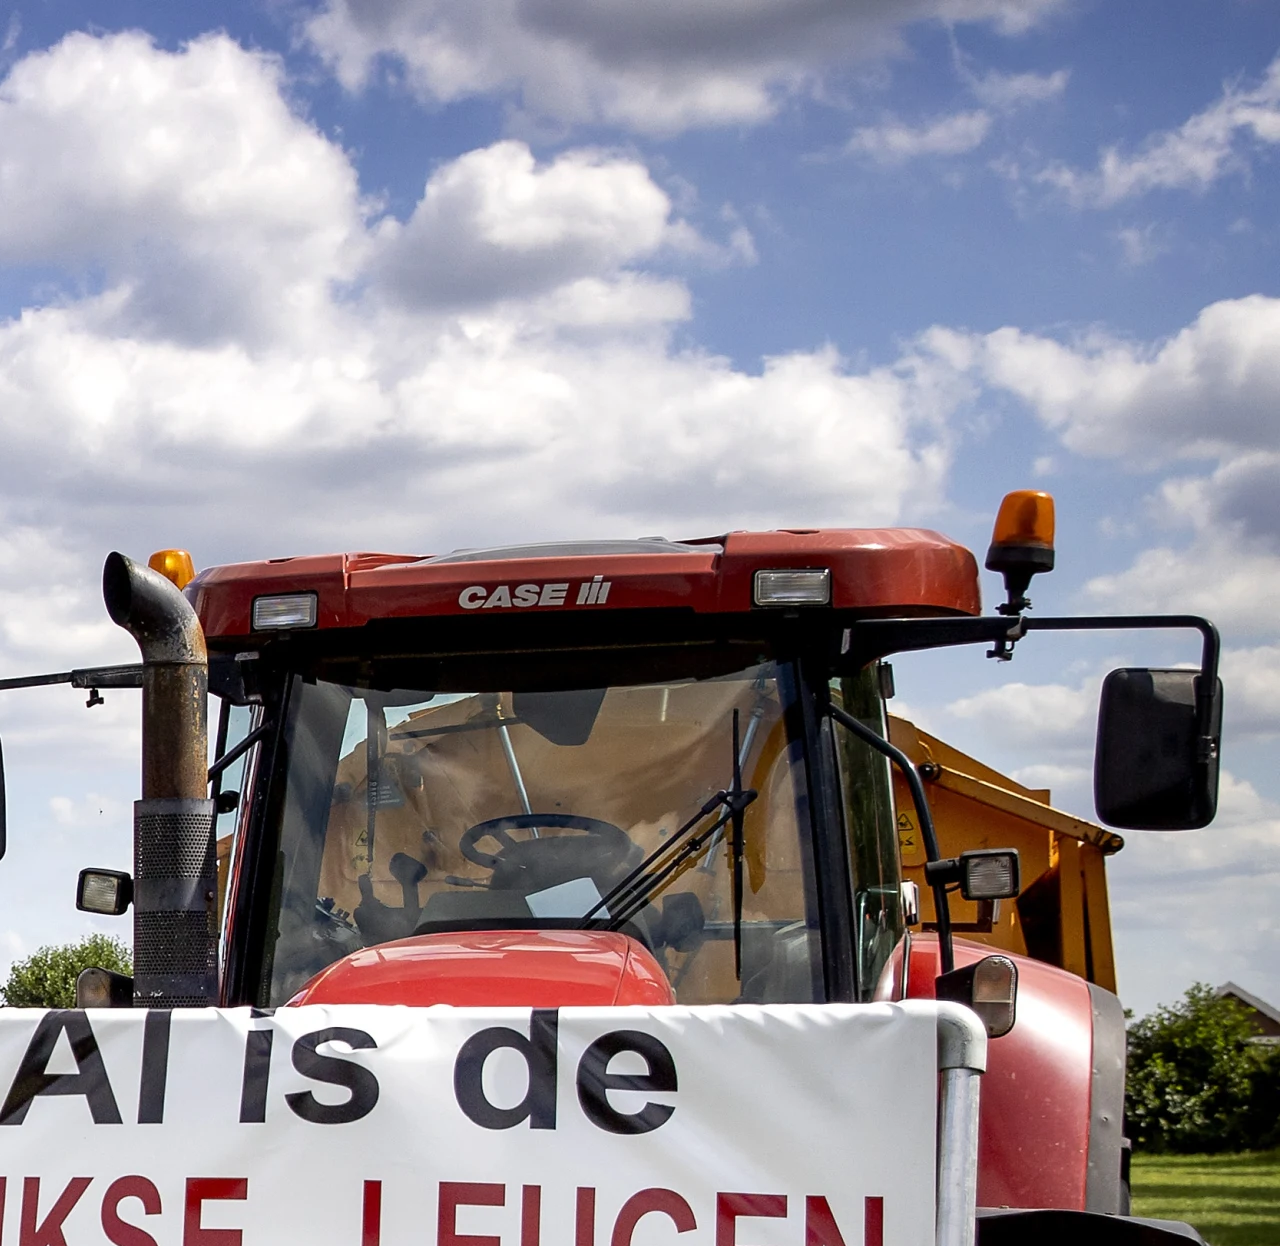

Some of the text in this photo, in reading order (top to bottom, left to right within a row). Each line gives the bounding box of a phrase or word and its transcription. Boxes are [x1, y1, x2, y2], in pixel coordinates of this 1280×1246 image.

[458, 583, 569, 610] CASE
[239, 1007, 380, 1125] is
[454, 1008, 678, 1135] de
